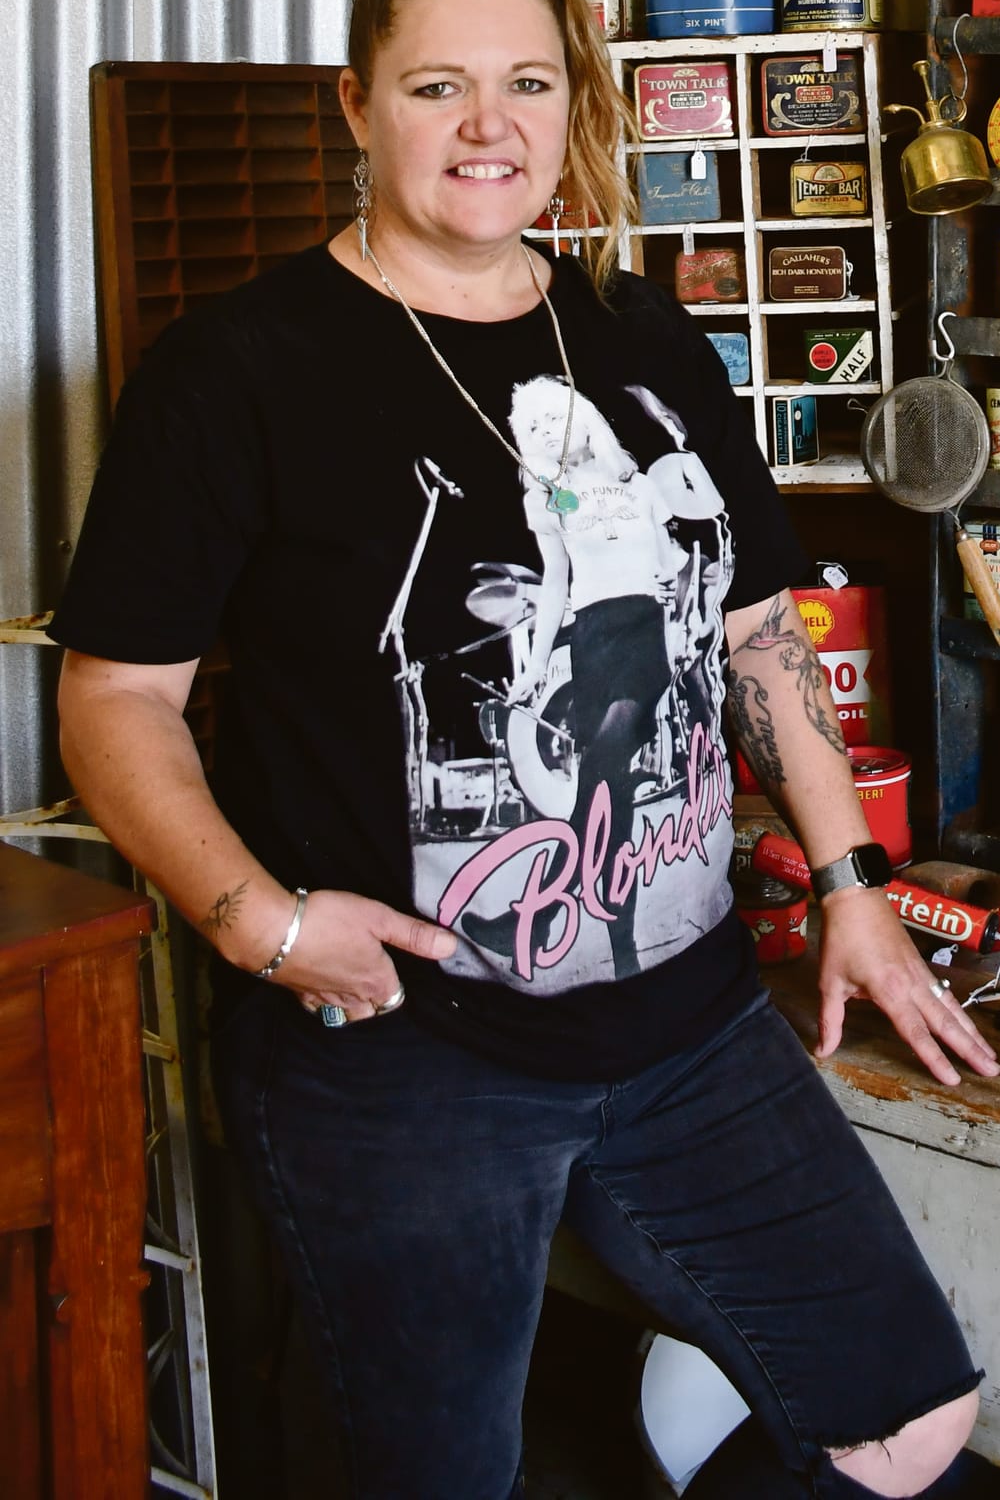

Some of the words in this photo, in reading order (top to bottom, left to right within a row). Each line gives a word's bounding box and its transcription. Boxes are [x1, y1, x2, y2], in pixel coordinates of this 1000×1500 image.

[684, 19, 701, 28] SIX
[796, 178, 831, 201] TEMP
[838, 179, 861, 199] BAR
[782, 253, 832, 266] GALLAHERS
[839, 348, 868, 382] HALF
[857, 787, 884, 800] BERT
[438, 721, 732, 980] Blondie
[887, 891, 960, 935] rtein
